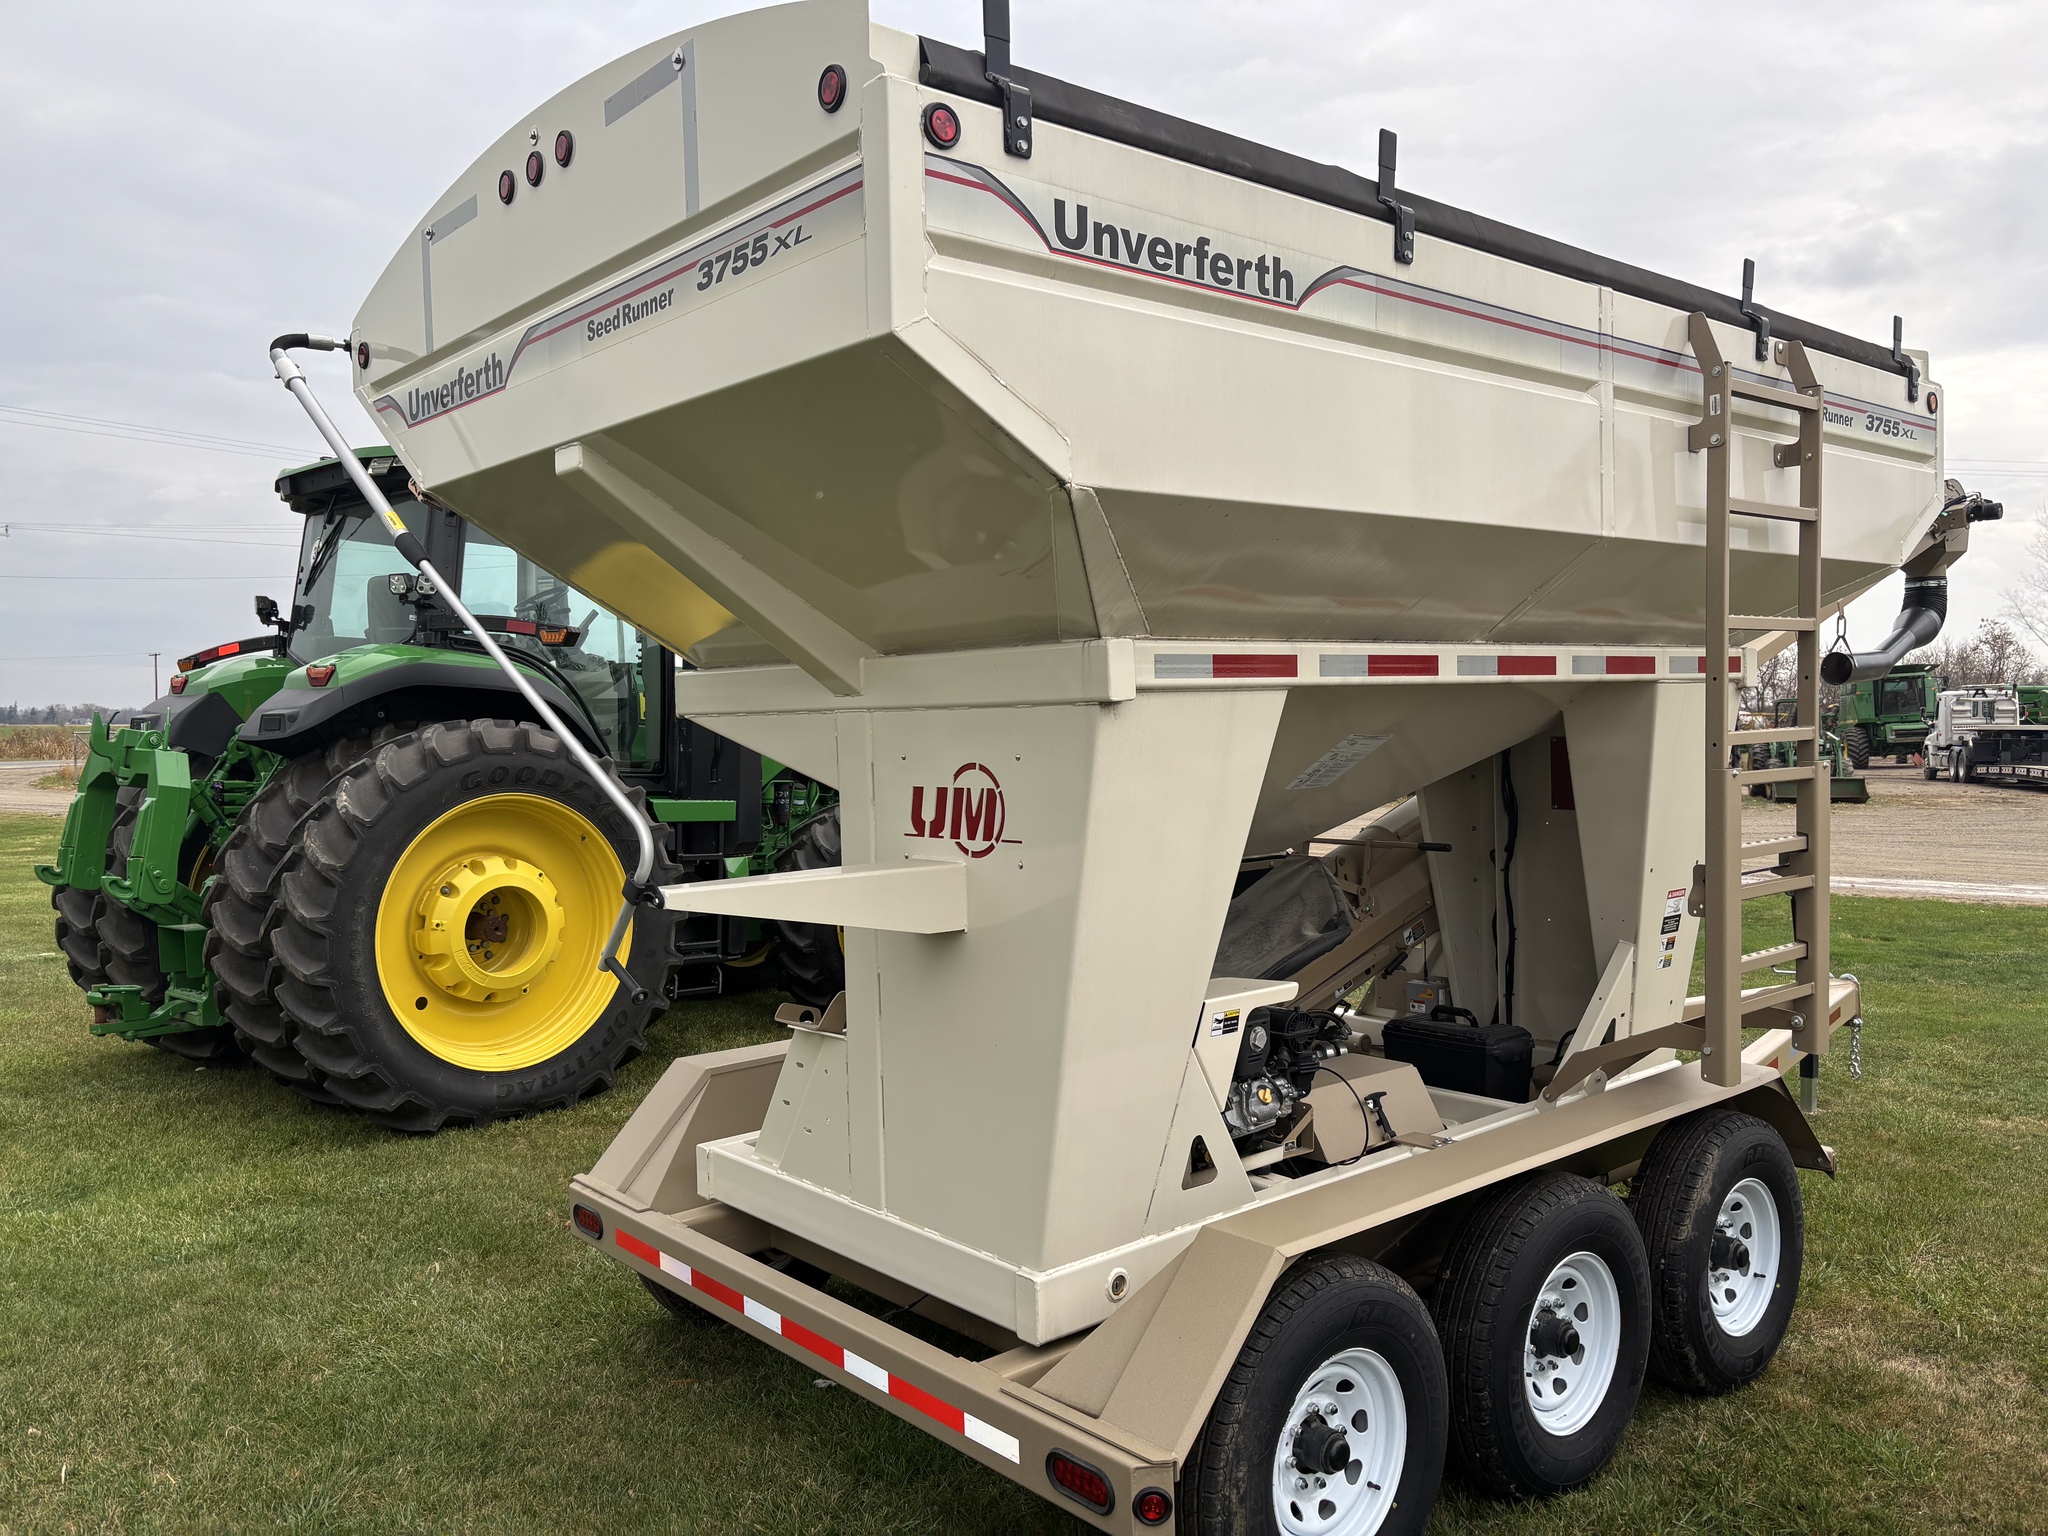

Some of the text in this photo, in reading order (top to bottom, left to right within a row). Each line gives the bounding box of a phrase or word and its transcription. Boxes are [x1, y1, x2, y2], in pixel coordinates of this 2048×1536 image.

[1054, 198, 1294, 302] Unverferth
[407, 352, 504, 421] Unverferth
[496, 1009, 628, 1098] OPTITRAC
